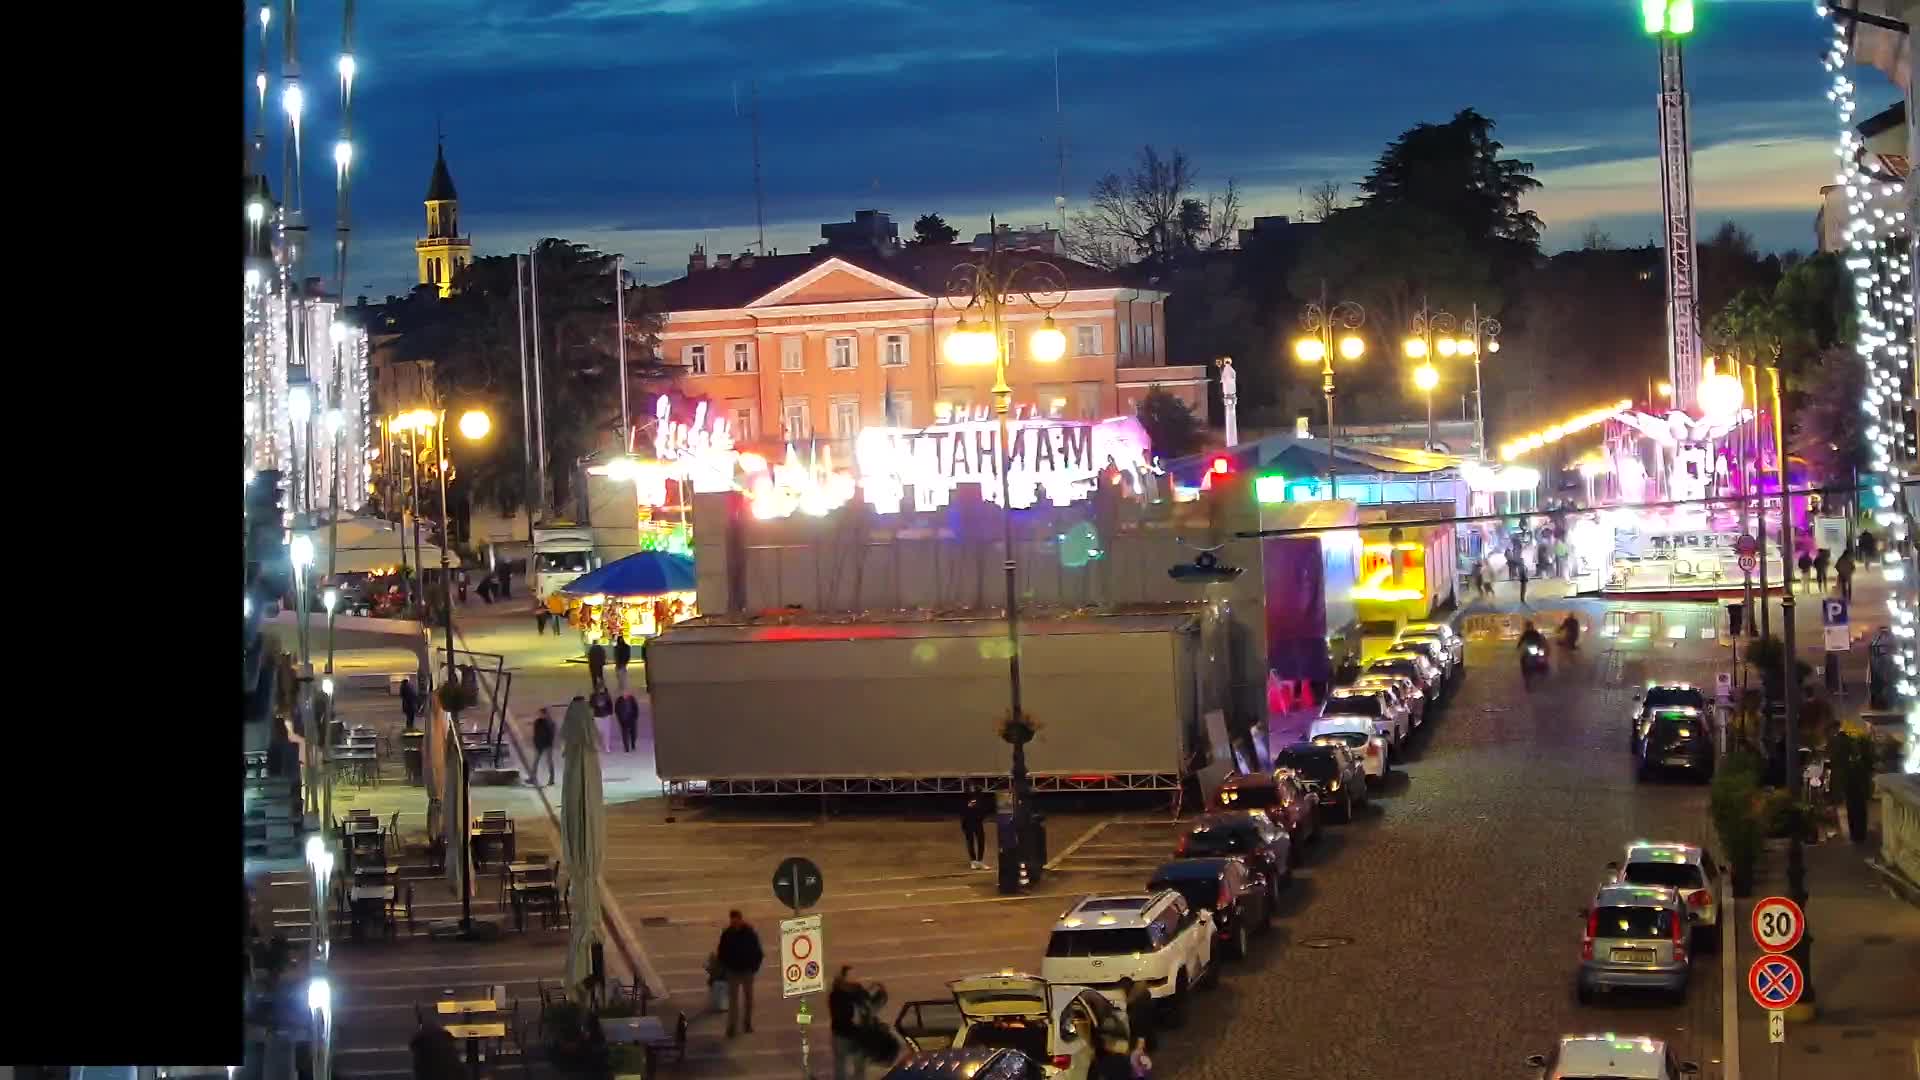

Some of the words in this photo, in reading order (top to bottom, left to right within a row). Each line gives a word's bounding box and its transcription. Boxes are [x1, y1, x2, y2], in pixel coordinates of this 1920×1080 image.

[1743, 558, 1753, 567] 20
[1827, 603, 1842, 621] P
[1762, 912, 1791, 937] 30
